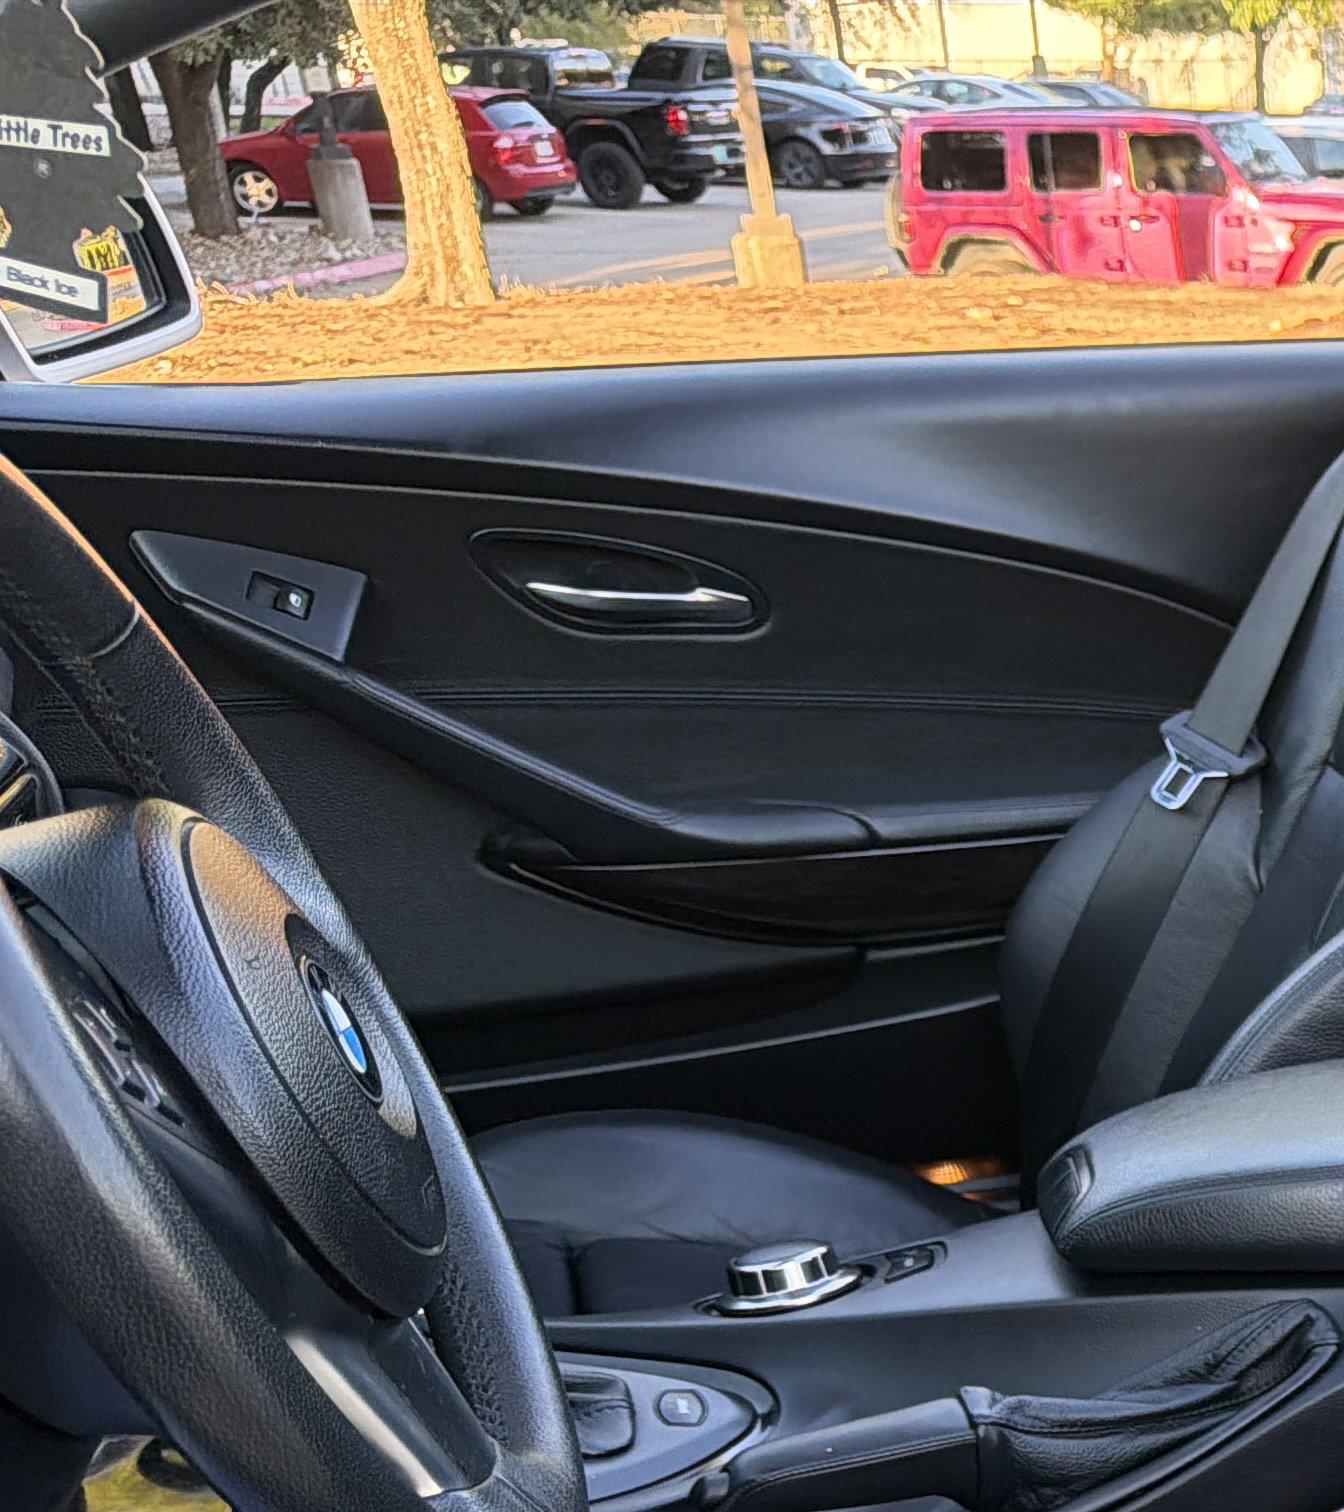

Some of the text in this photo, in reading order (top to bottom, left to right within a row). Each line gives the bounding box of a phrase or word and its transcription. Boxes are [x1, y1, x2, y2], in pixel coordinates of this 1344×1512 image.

[0, 118, 103, 152] ittle Trees
[7, 266, 79, 297] Black Ice
